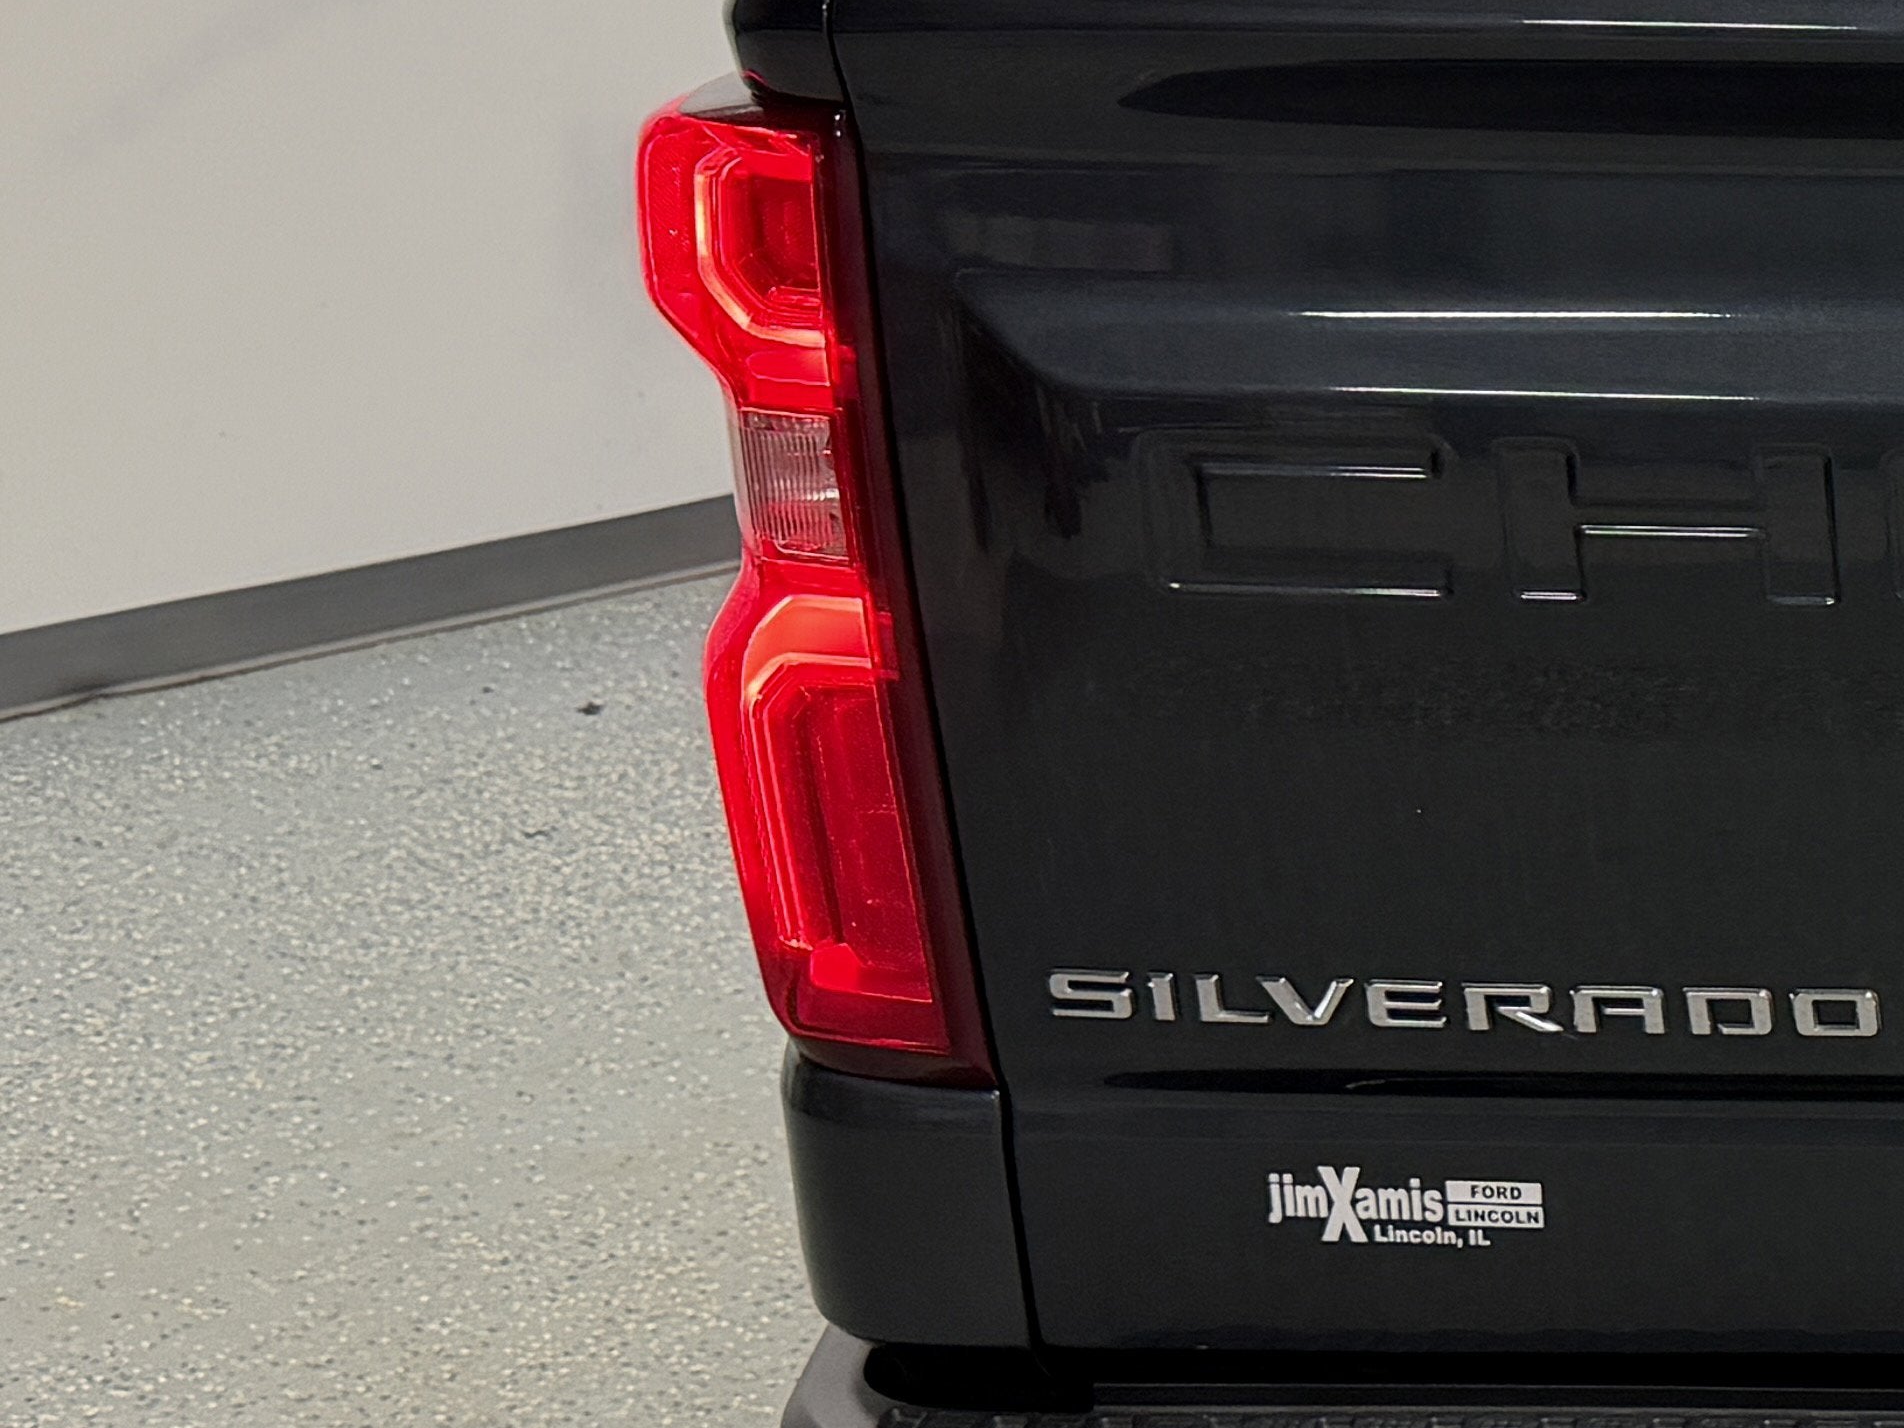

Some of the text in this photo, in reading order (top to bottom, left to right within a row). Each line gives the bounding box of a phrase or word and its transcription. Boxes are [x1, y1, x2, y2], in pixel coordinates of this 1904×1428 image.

[1046, 967, 1884, 1039] SILVERADO
[1469, 1184, 1523, 1200] FORD
[1454, 1208, 1541, 1225] LINCOLN
[1372, 1224, 1492, 1249] Lincoln, IL
